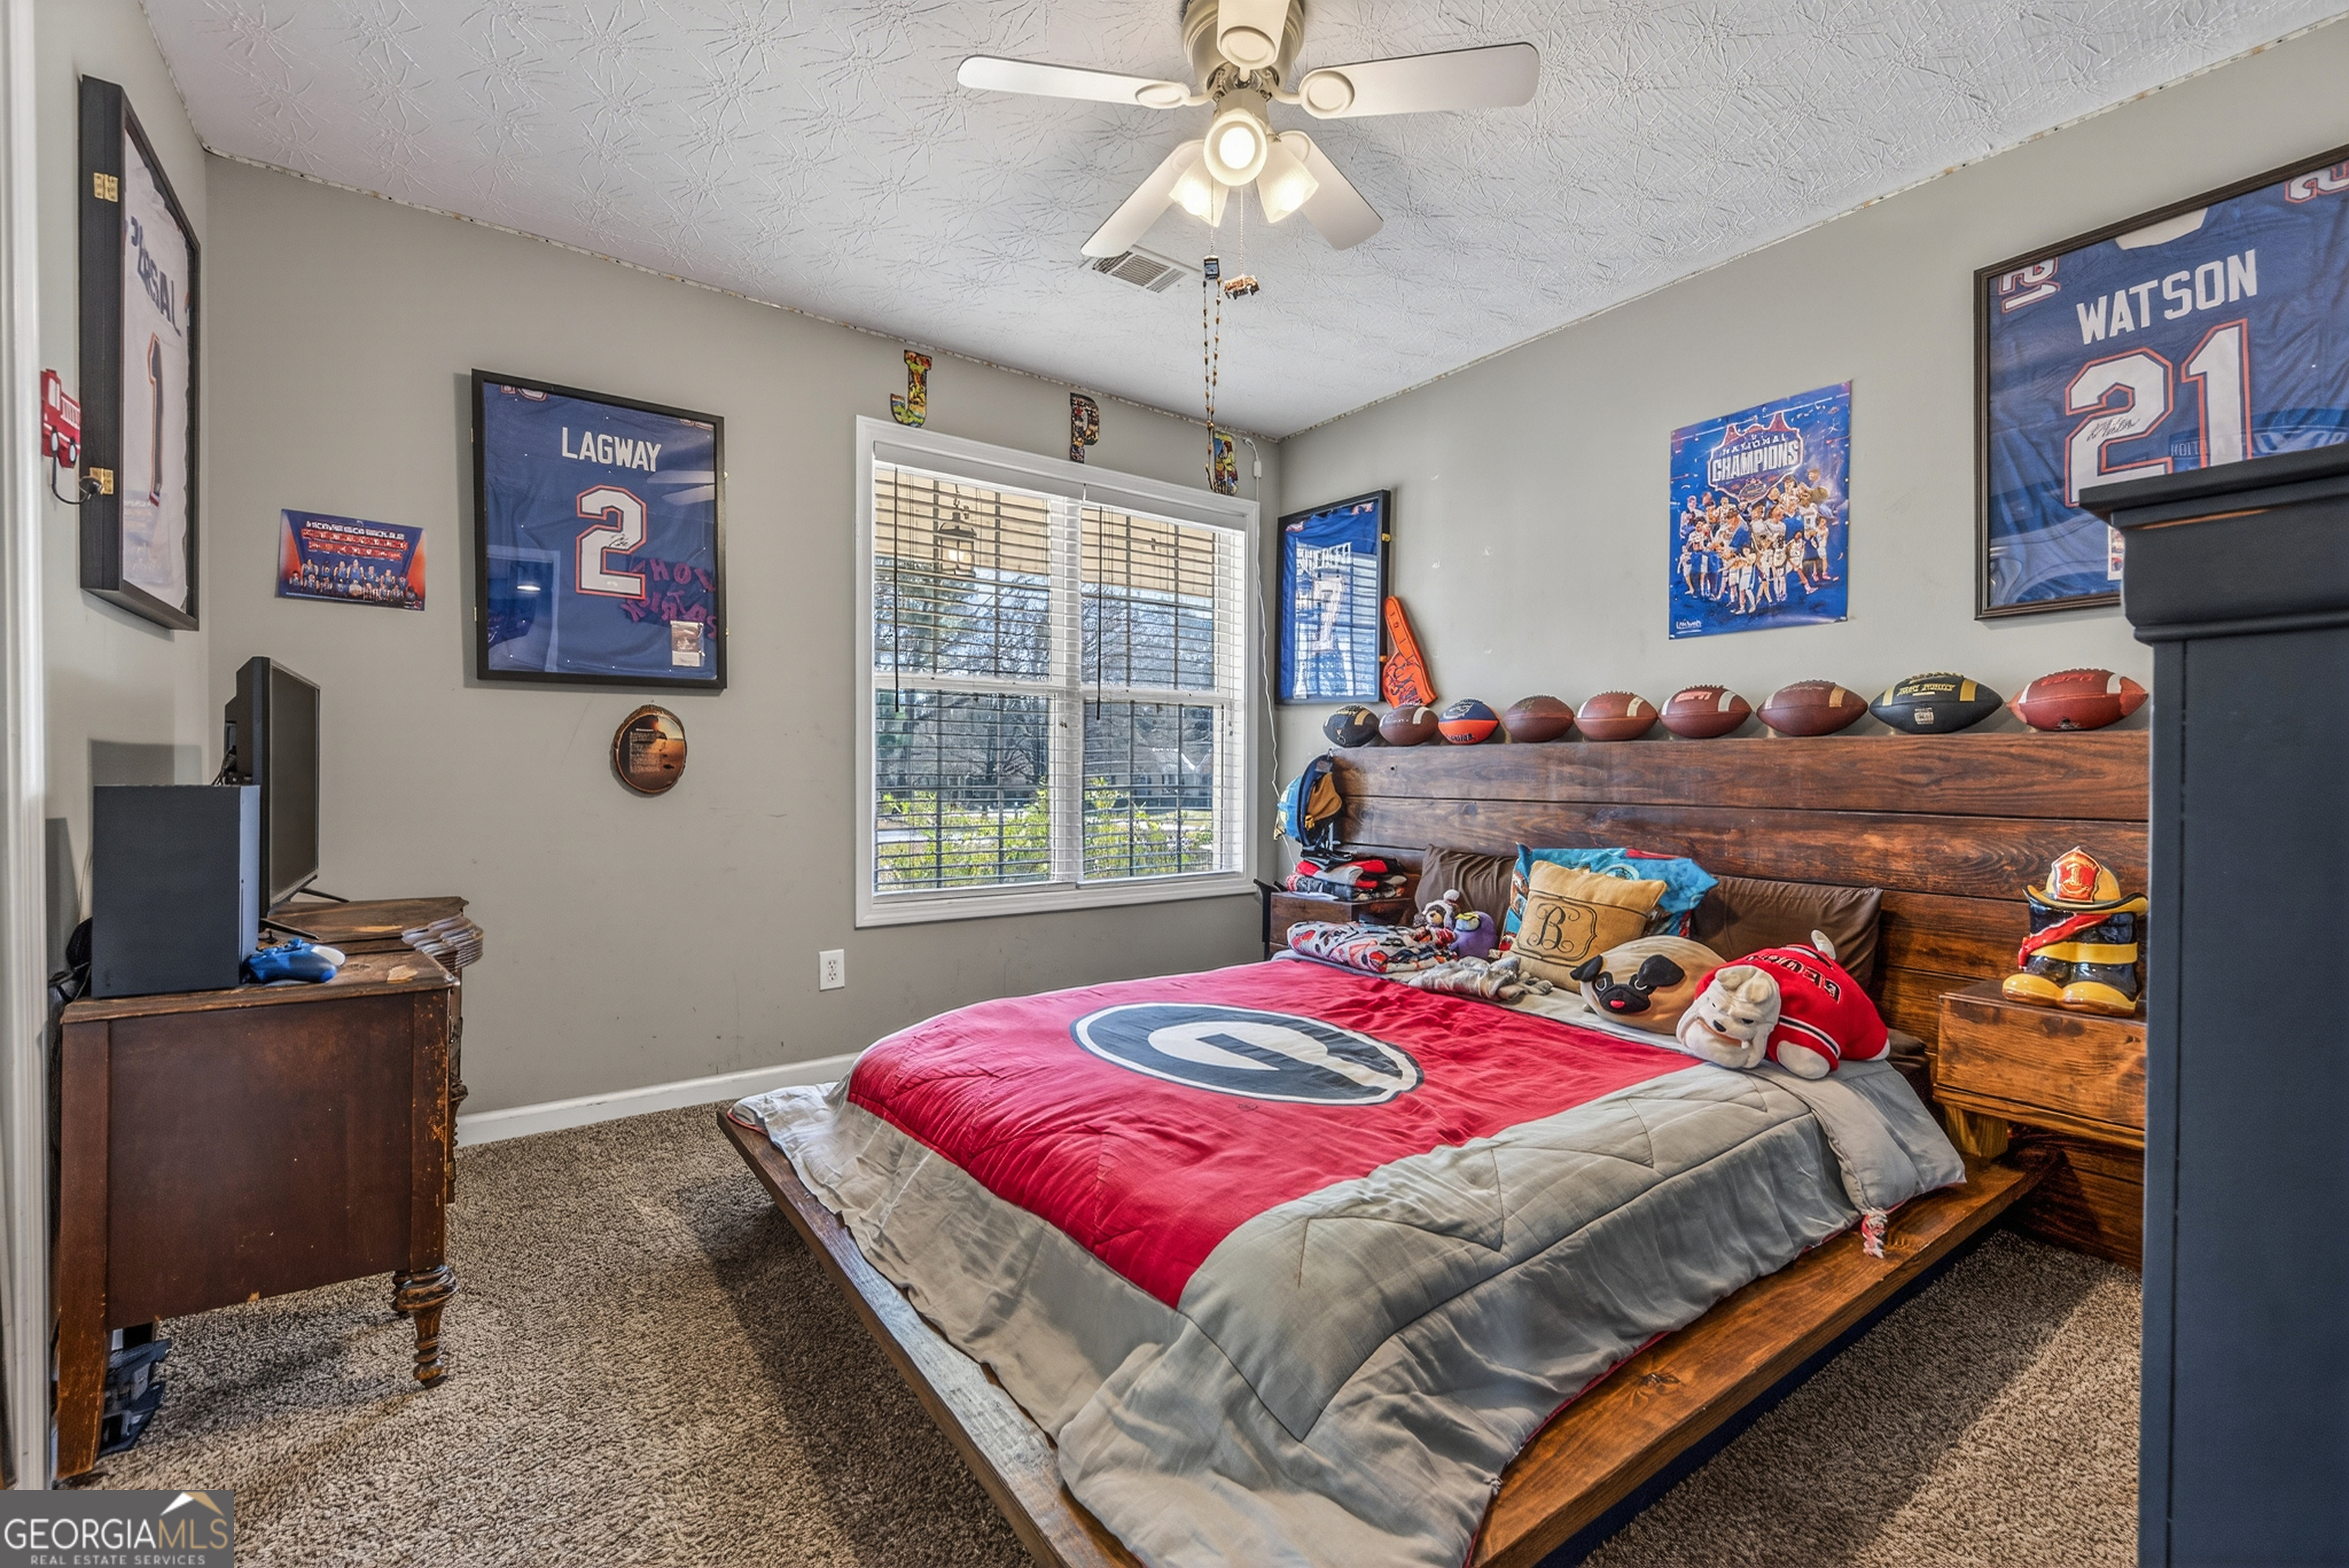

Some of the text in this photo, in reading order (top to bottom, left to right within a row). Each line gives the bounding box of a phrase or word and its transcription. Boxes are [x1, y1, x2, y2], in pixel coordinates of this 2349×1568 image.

[2077, 249, 2258, 346] WATSON
[148, 332, 165, 507] 1
[562, 427, 661, 472] LAGWAY
[890, 349, 932, 428] J
[1070, 392, 1100, 463] P
[2065, 318, 2253, 508] 21
[1712, 440, 1799, 482] CHAMPIONS
[576, 485, 647, 600] 2
[1311, 575, 1344, 657] 7
[1527, 902, 1580, 953] B
